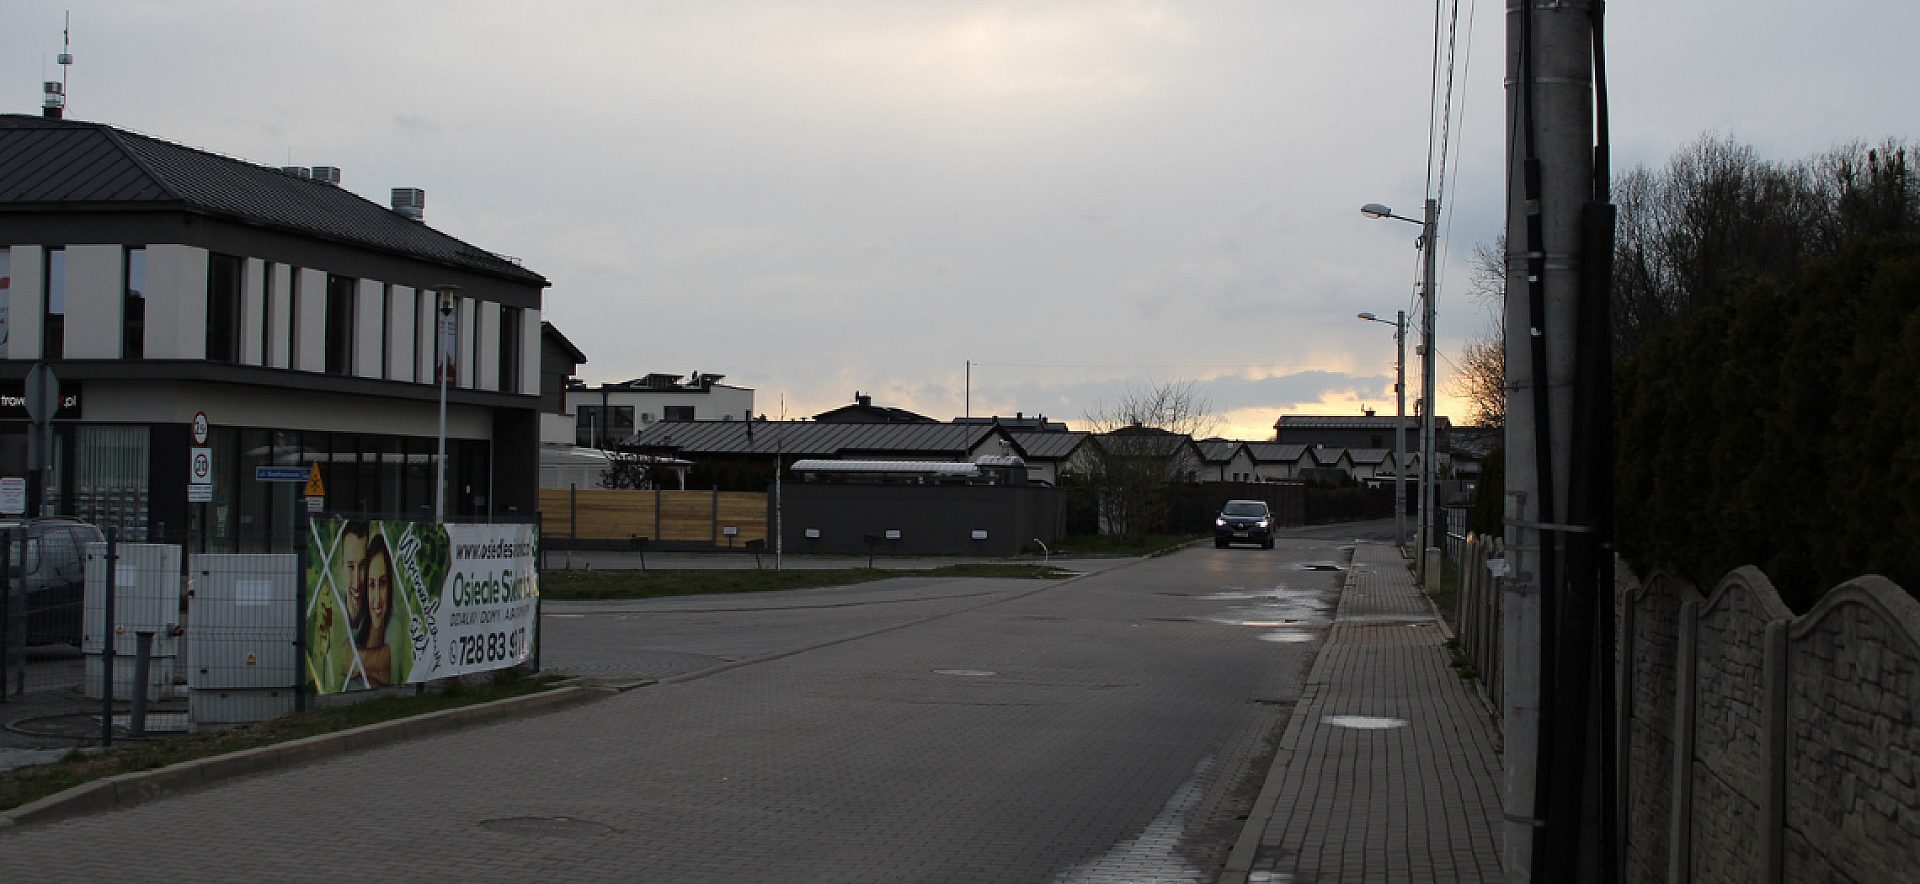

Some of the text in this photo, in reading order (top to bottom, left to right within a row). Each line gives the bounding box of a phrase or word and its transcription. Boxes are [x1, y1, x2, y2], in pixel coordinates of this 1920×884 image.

[453, 571, 499, 606] Osiedle
[460, 634, 484, 665] 728
[487, 632, 506, 662] 83
